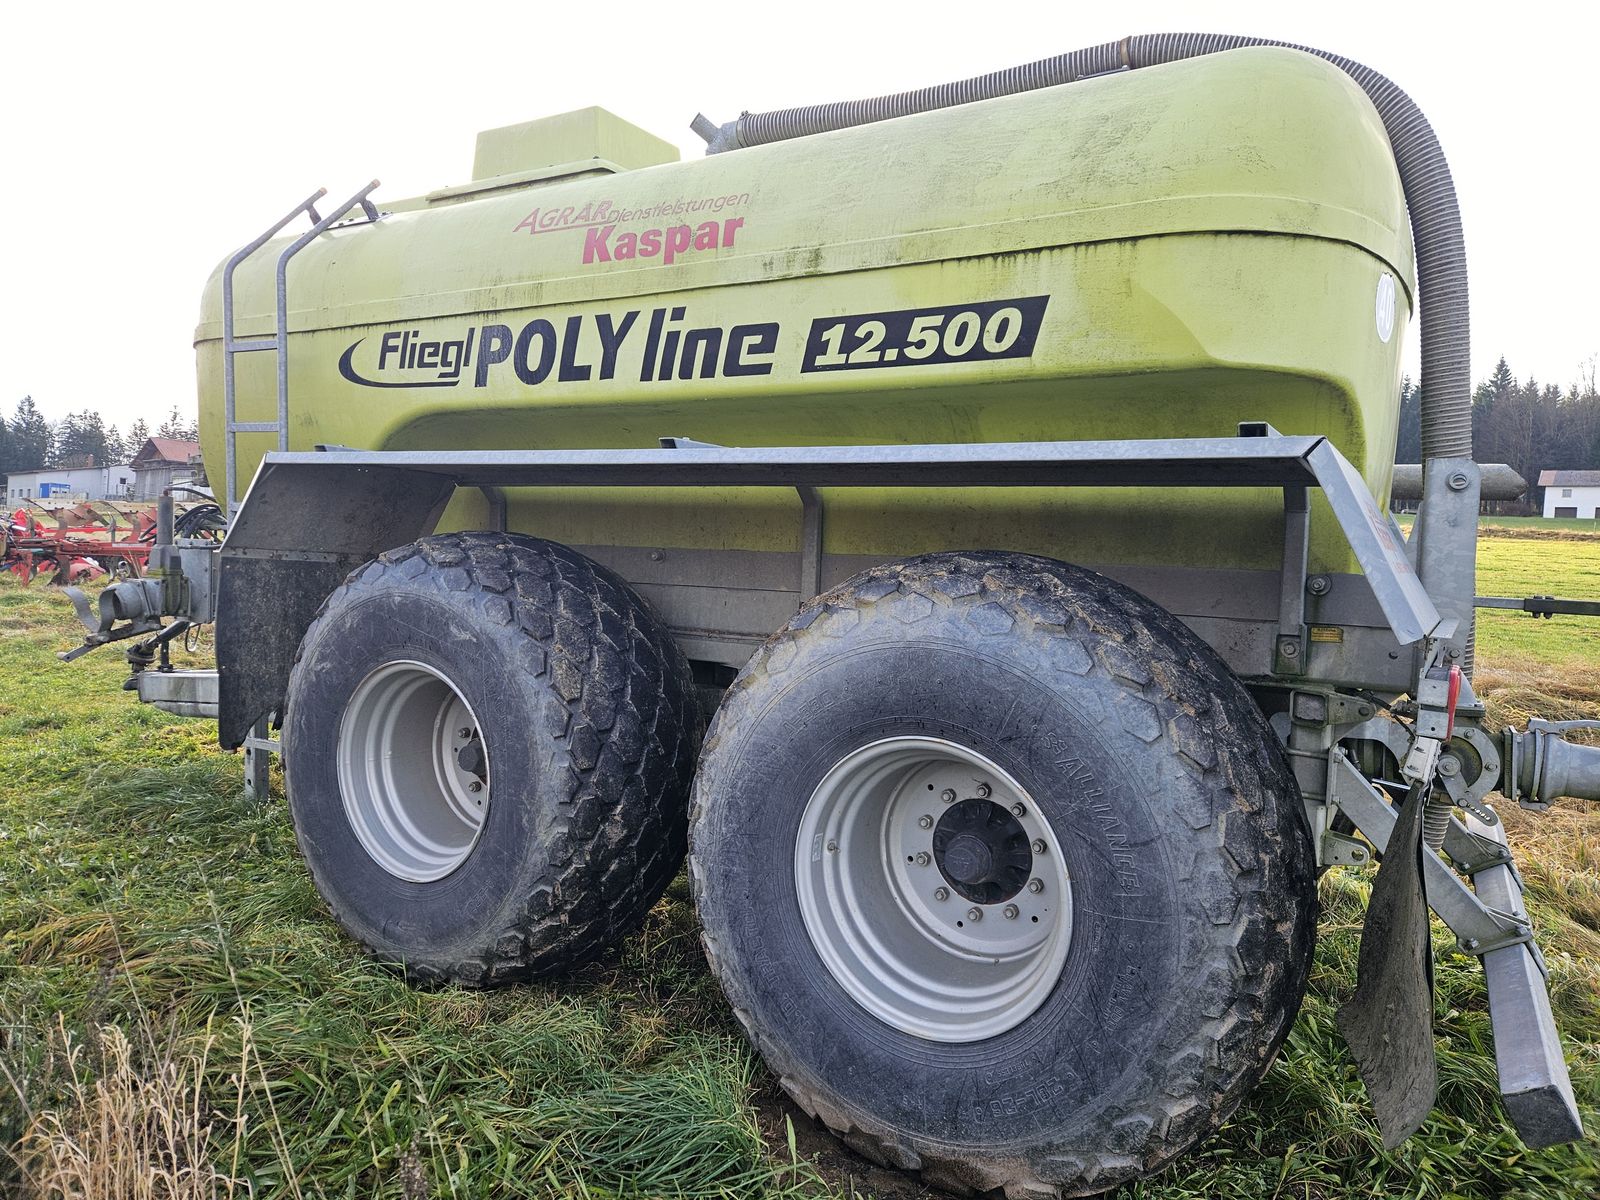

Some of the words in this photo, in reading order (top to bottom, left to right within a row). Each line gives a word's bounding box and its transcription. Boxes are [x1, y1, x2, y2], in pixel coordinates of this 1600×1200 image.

[512, 200, 613, 235] AGRAR
[607, 193, 750, 224] Dienstleistungen
[582, 217, 745, 265] Kaspar
[378, 329, 476, 379] Fliegl
[814, 307, 1023, 366] 12.500
[1055, 756, 1141, 889] ALLIANCE
